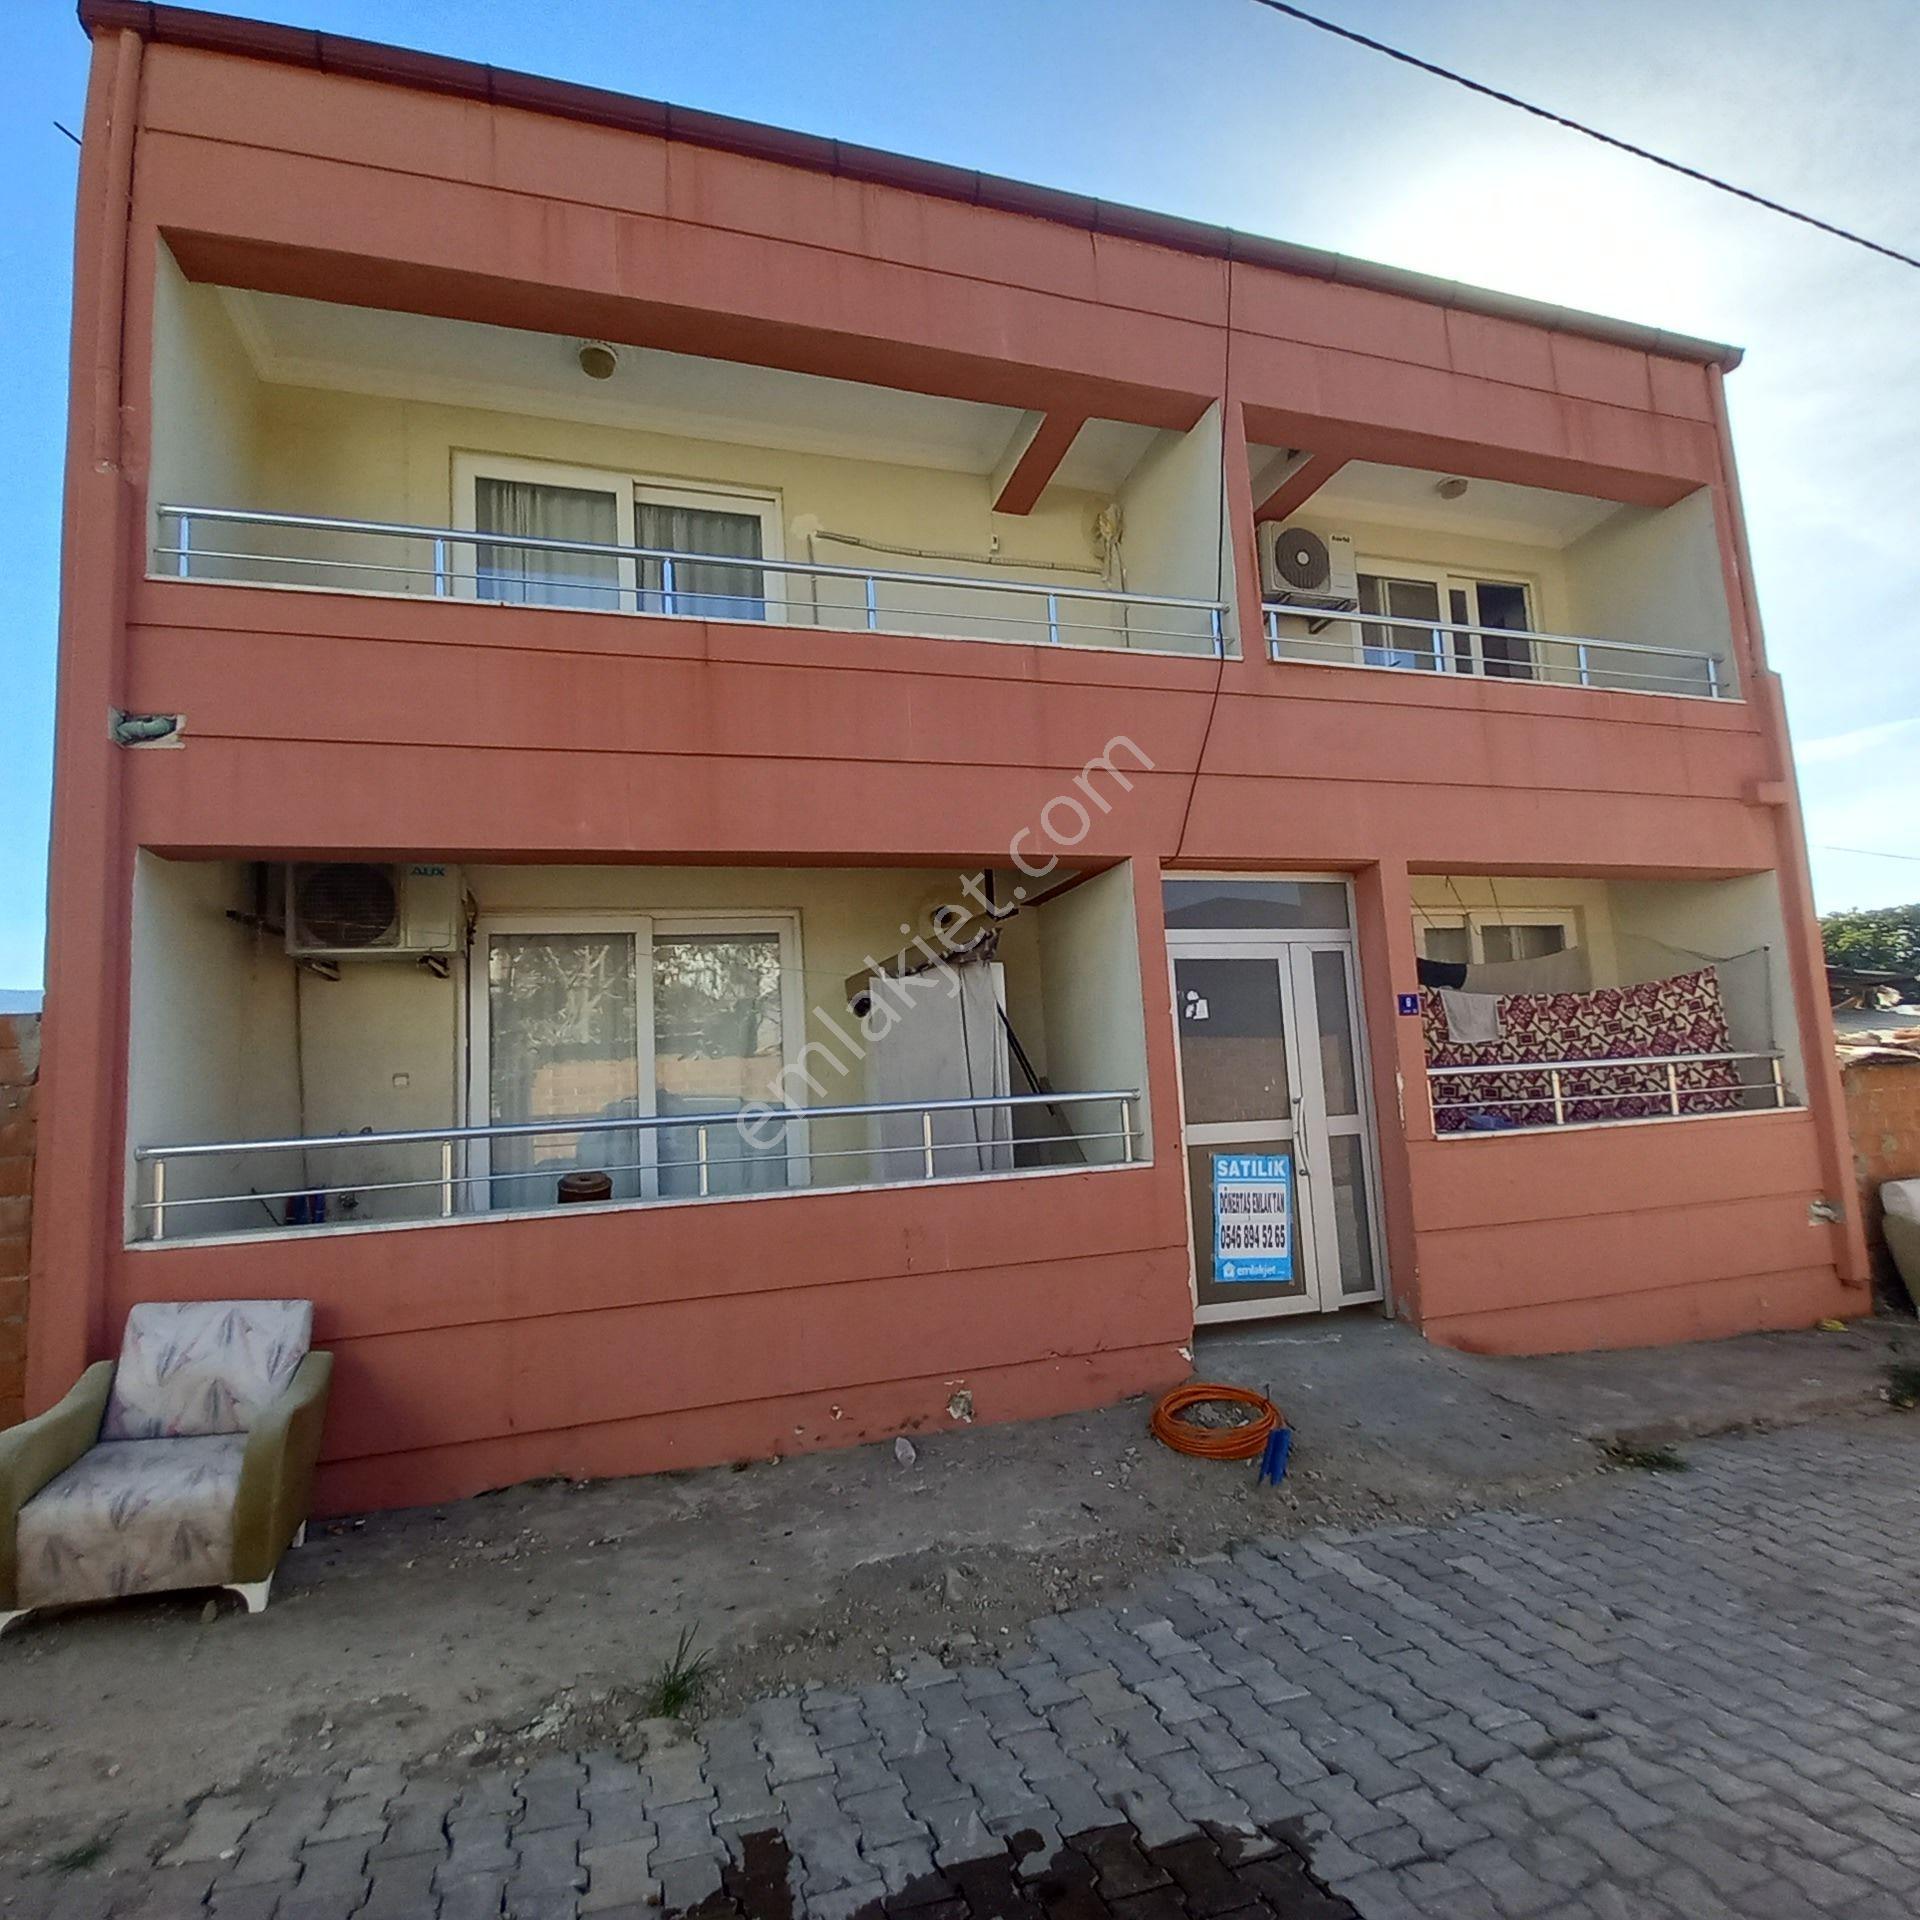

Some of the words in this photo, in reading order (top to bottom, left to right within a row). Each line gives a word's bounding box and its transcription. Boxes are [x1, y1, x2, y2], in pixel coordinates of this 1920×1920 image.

[410, 866, 445, 877] AUX
[1217, 1159, 1286, 1177] SATILIK
[1220, 1224, 1241, 1249] 0546
[1243, 1224, 1260, 1249] 894
[1262, 1224, 1273, 1248] 52
[1275, 1224, 1286, 1248] 65
